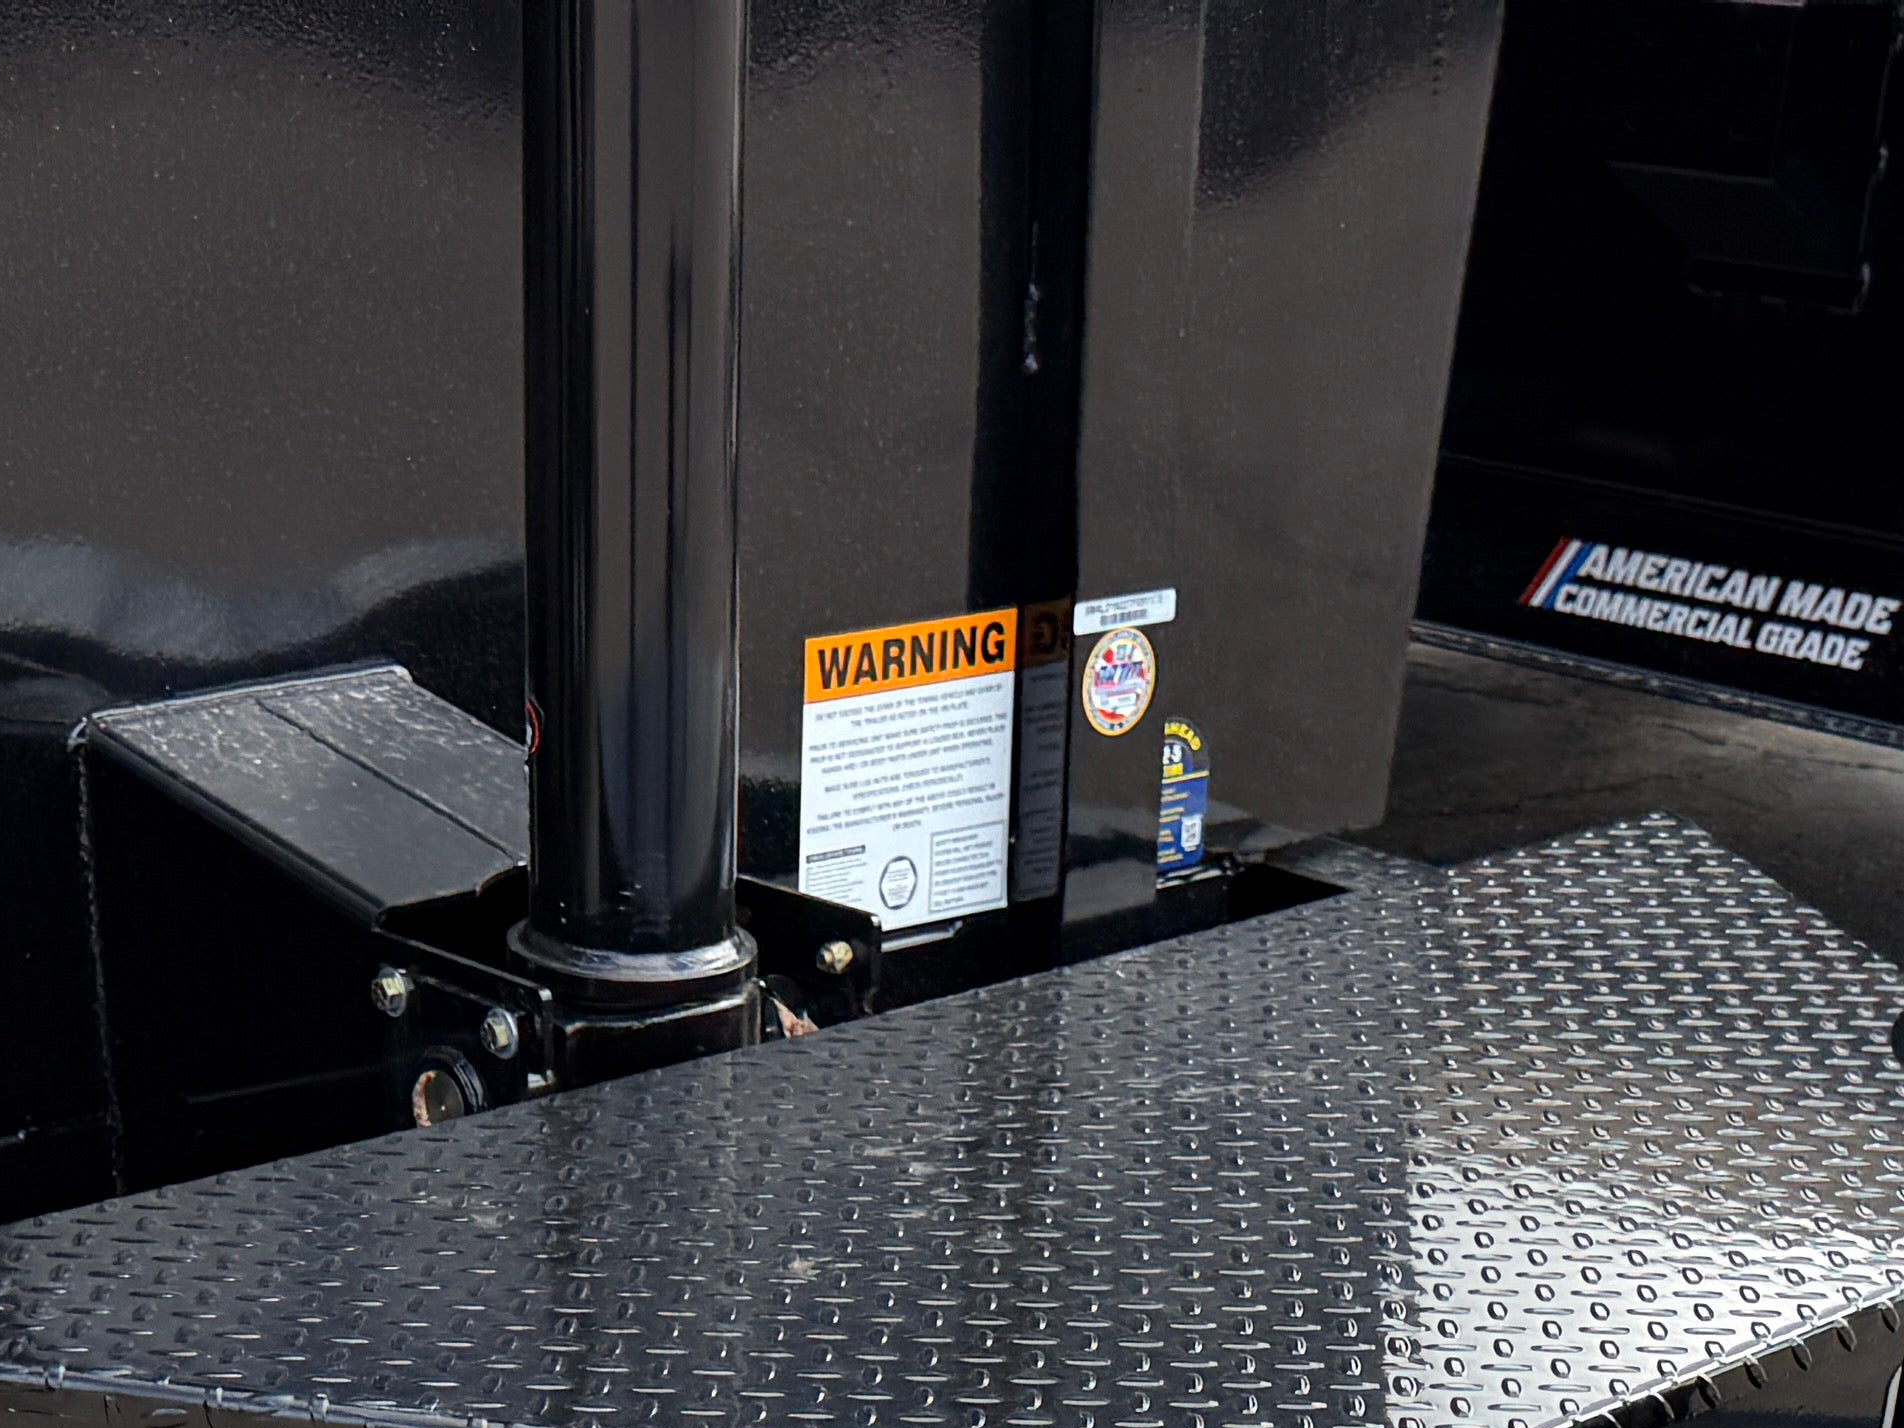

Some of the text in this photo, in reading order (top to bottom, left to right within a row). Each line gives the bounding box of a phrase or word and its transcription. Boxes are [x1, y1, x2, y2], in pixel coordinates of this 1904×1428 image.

[1554, 583, 1870, 671] COMMERCIAL GRADE
[1577, 544, 1902, 636] AMERICAN MADE
[818, 620, 1006, 690] WARNING
